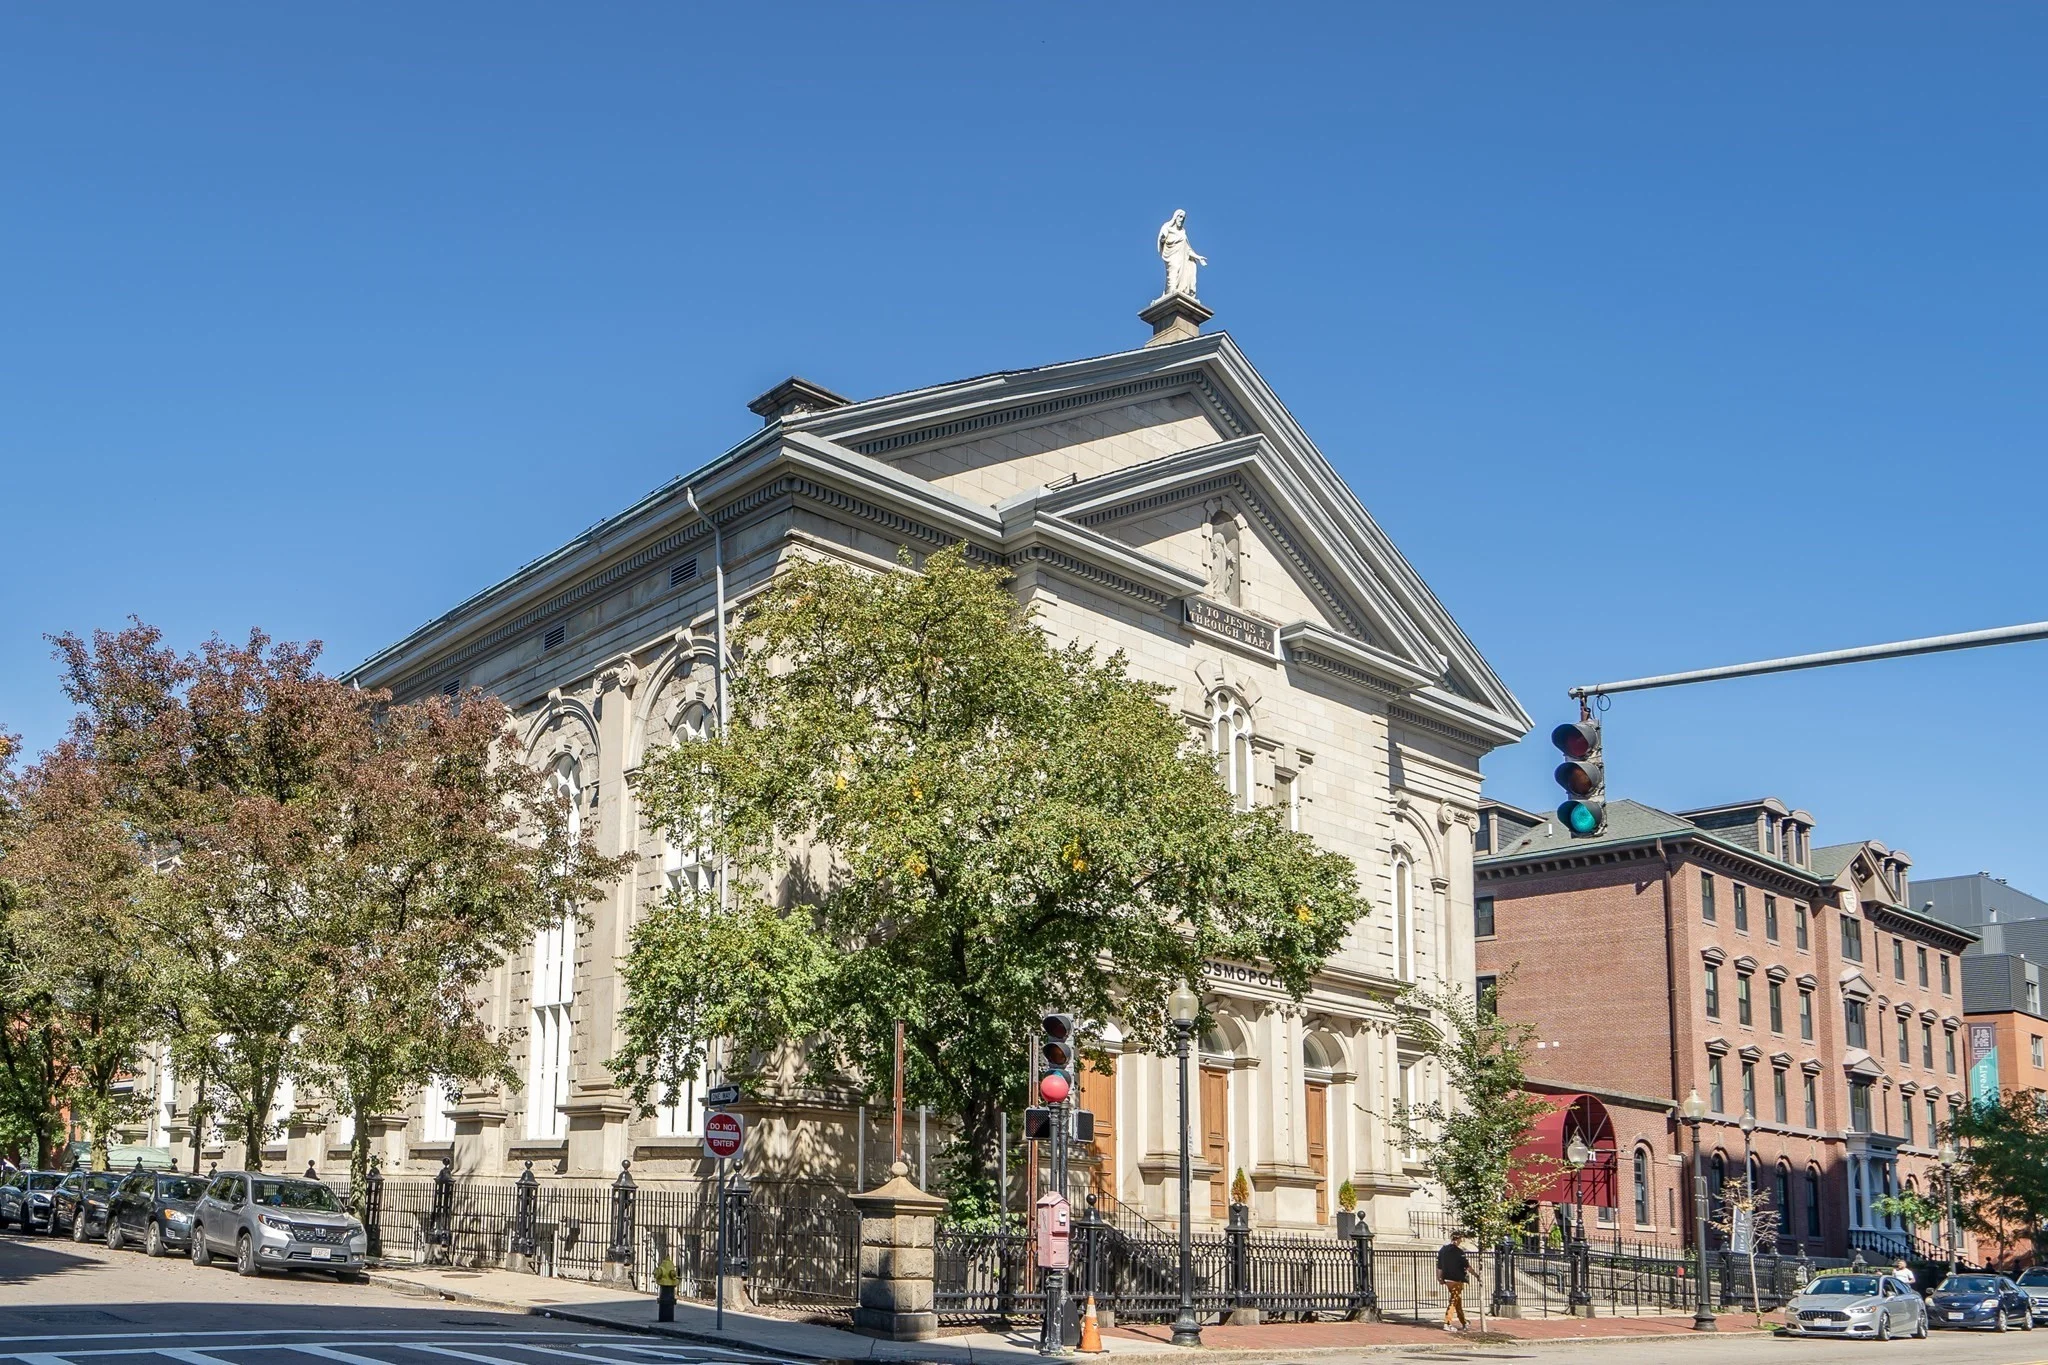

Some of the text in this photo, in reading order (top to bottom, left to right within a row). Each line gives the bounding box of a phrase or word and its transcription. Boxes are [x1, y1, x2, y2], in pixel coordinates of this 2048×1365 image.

[1190, 611, 1271, 651] THROUGH MARY
[1207, 606, 1256, 634] TO JESUS
[1202, 960, 1283, 989] OSMOPOLI
[712, 1091, 731, 1101] ONE WAY
